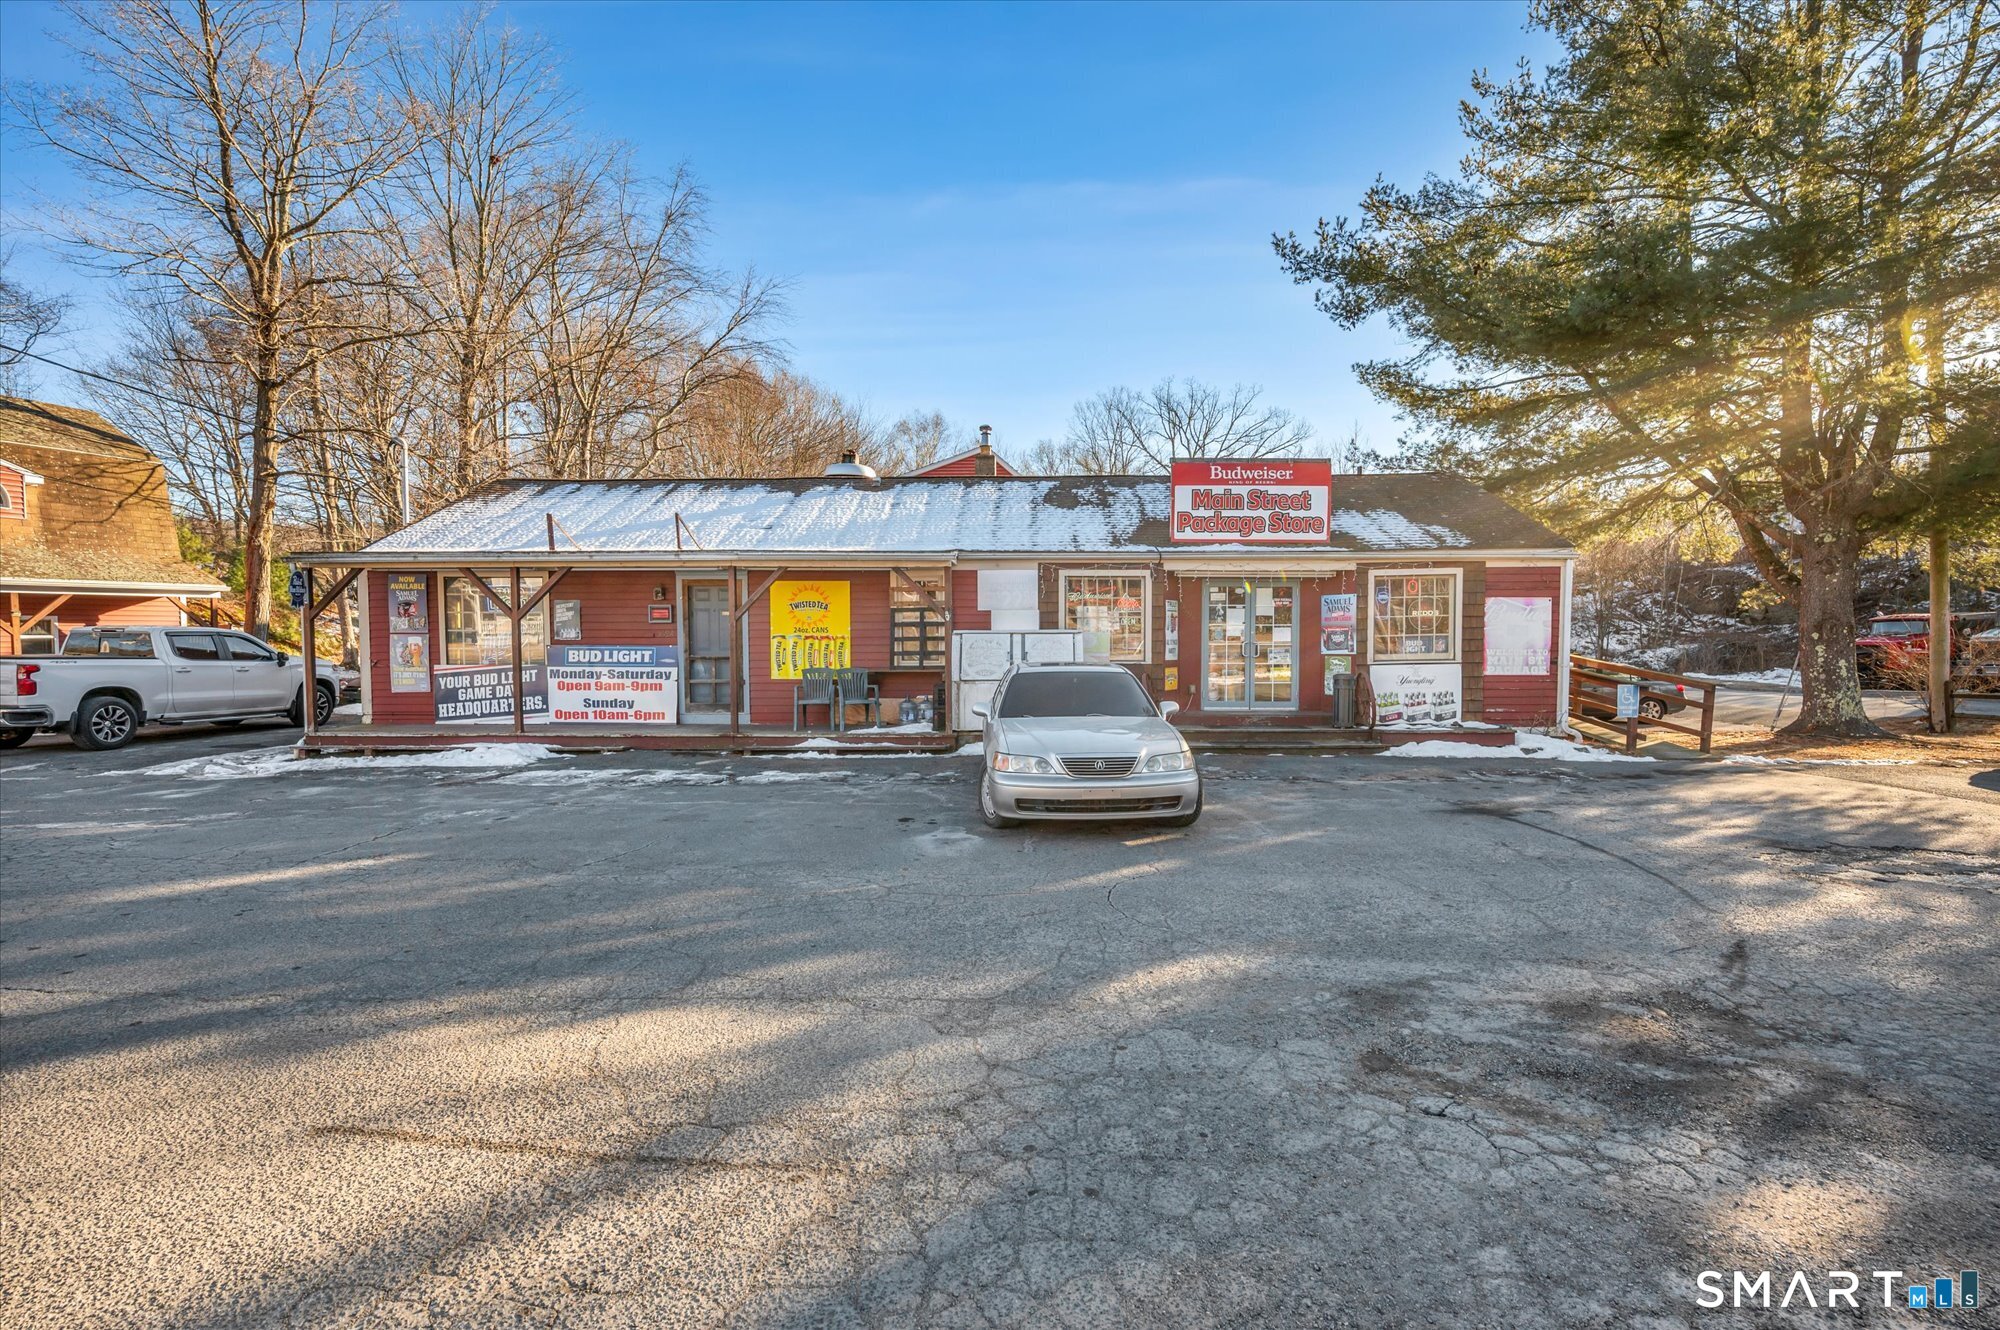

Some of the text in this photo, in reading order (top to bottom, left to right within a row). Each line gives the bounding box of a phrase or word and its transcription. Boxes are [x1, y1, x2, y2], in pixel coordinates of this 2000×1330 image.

[1210, 465, 1292, 480] Budweiser
[1192, 489, 1312, 510] Main Street
[1177, 511, 1325, 537] Package Store
[1407, 579, 1449, 594] OPEN
[789, 601, 829, 610] TWISTED TEA
[1323, 597, 1353, 606] SAMUEL
[1328, 605, 1351, 614] ADAMS
[568, 650, 652, 662] BUD LIGHT
[1487, 656, 1546, 664] MAIN ST.
[438, 670, 538, 690] YOUR BUD LIHT
[549, 669, 672, 680] Monday-Saturday
[558, 681, 663, 692] Open 9am-9pm
[458, 686, 492, 700] GAME
[584, 698, 634, 709] Sunday
[554, 710, 666, 720] Open 10am-6pm
